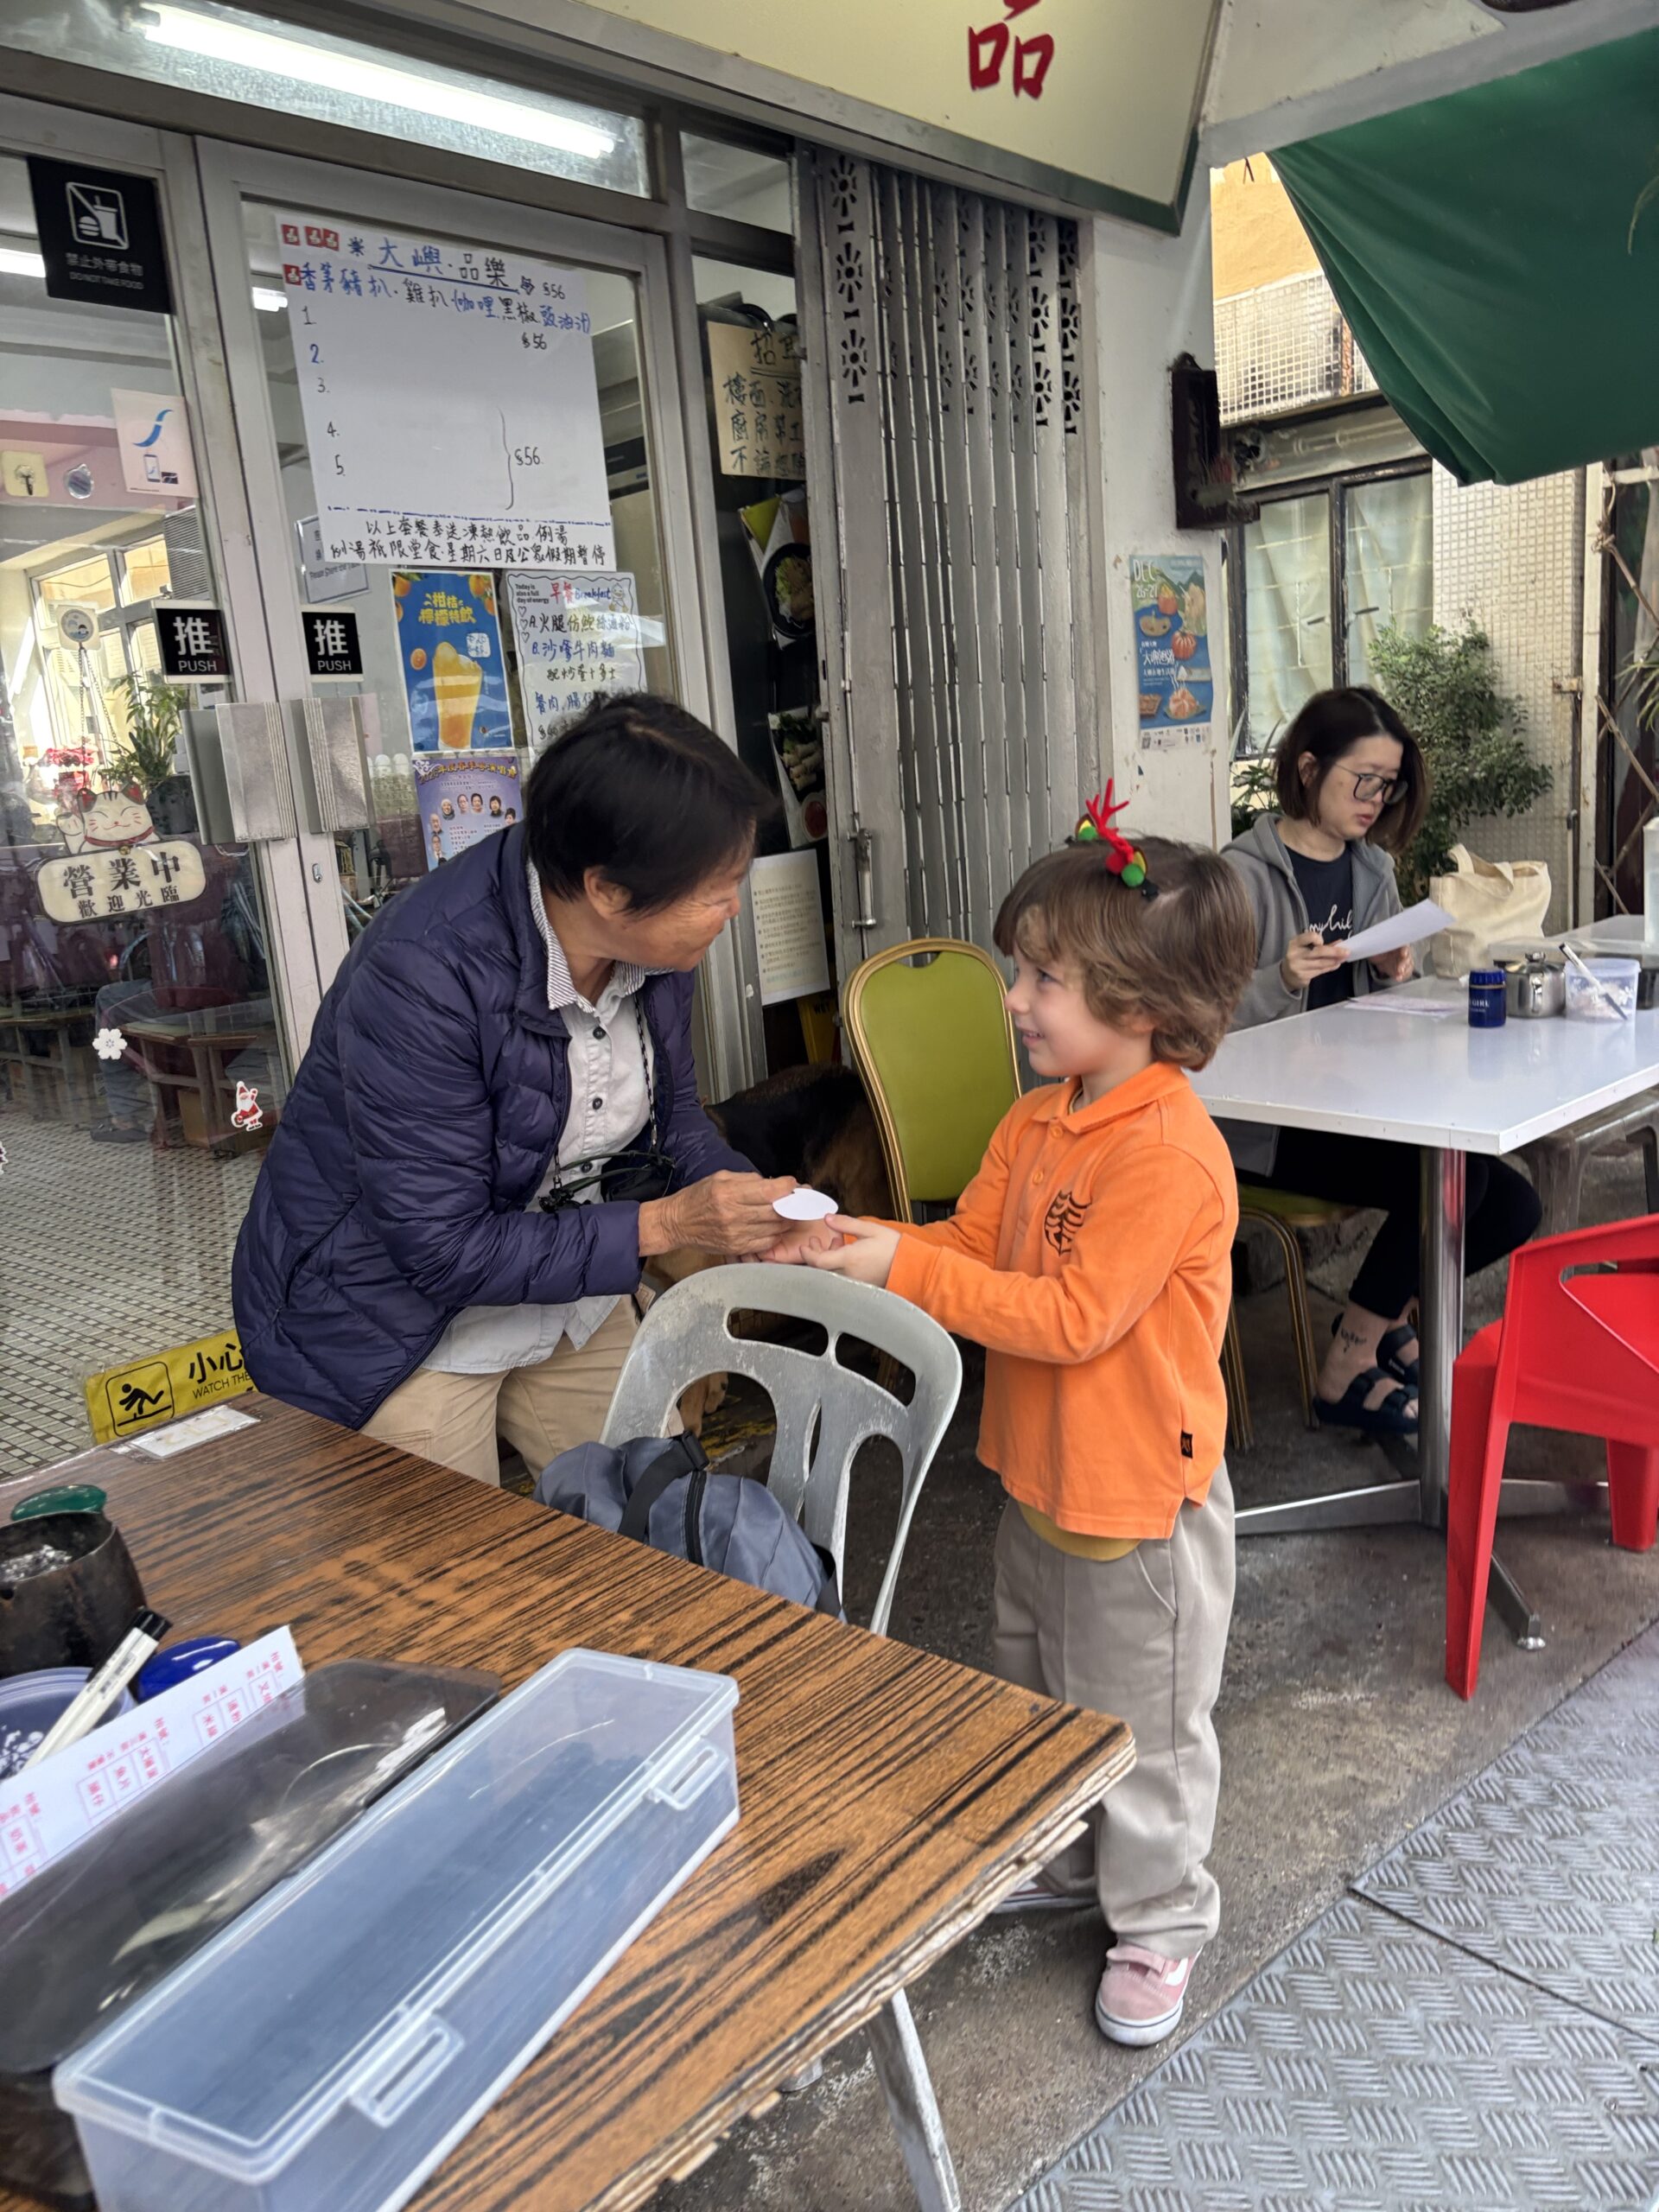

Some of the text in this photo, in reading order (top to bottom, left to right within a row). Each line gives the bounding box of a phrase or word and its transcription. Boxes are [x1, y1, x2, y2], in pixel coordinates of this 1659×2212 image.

[173, 616, 214, 657] 推
[313, 619, 349, 657] 推
[177, 660, 217, 672] PUSH
[317, 659, 352, 672] PUSH
[63, 851, 181, 899] 營業中
[78, 885, 180, 918] 歡迎光臨
[188, 1342, 245, 1384] 小心
[192, 1377, 230, 1400] WATCH
